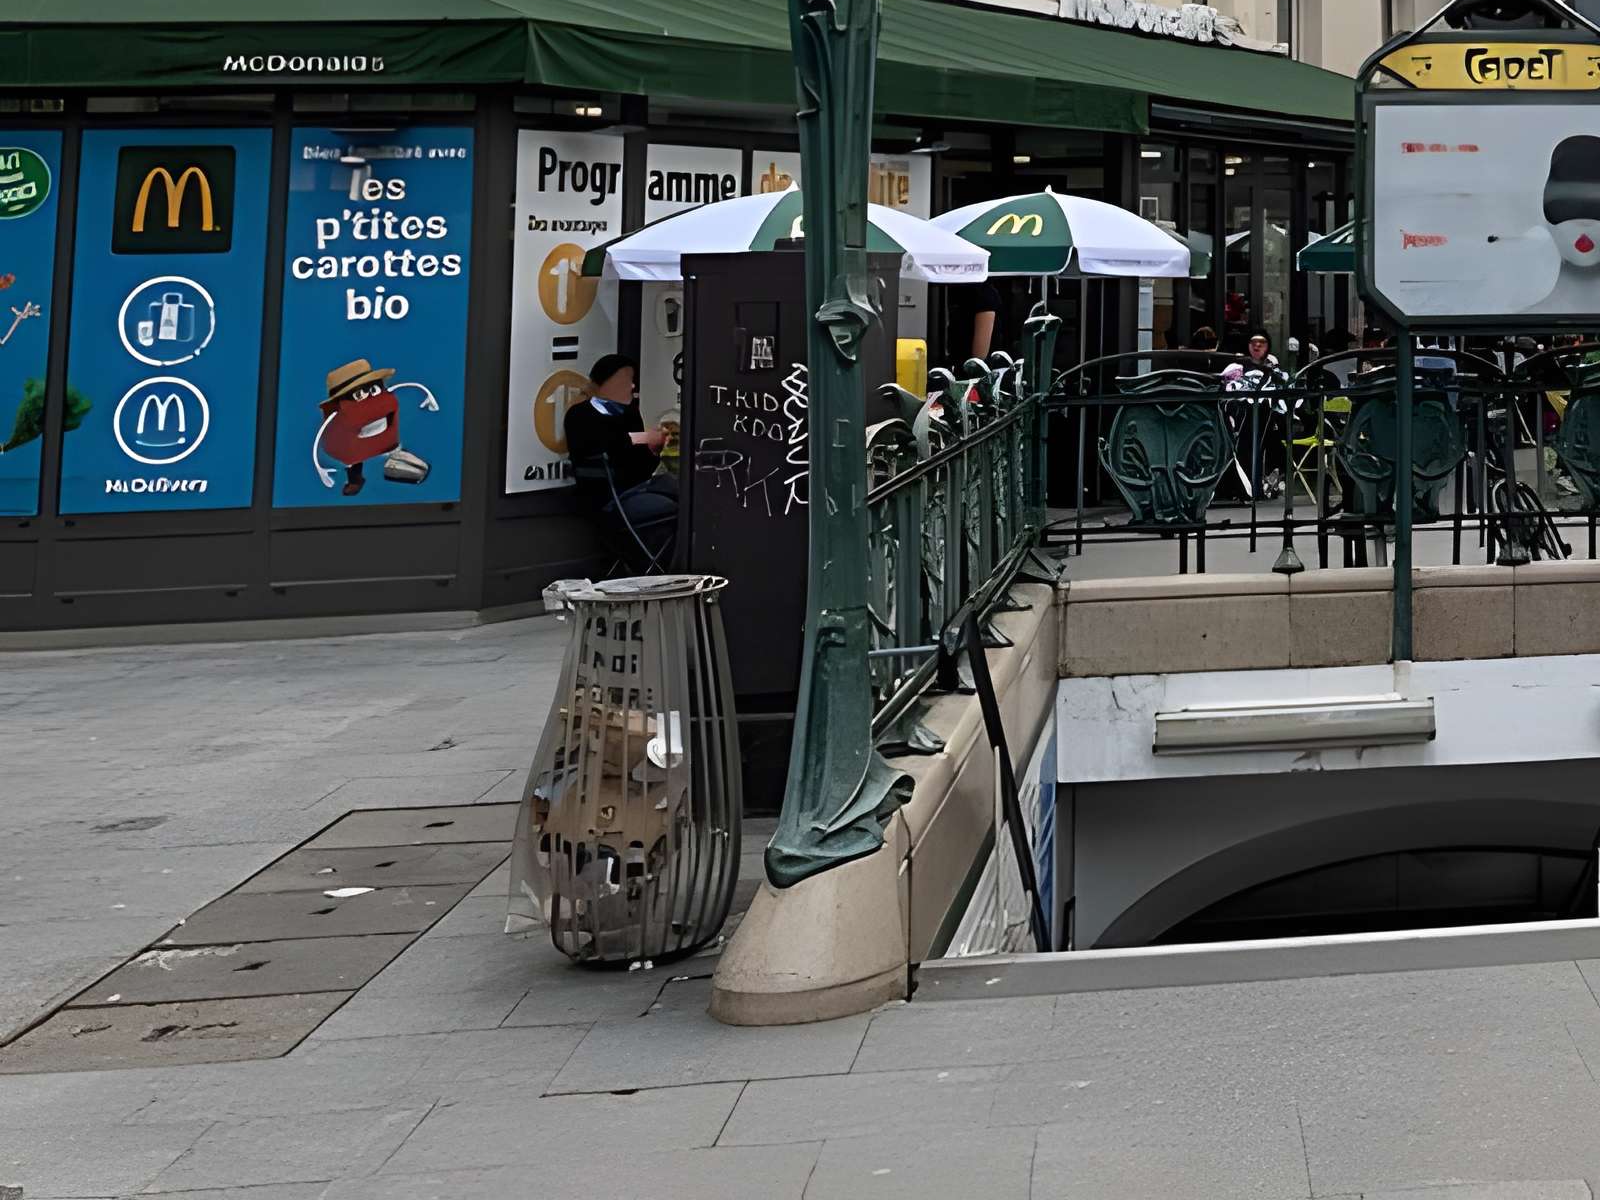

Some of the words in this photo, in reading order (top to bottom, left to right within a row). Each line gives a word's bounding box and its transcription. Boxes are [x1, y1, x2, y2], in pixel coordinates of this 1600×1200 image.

[1464, 48, 1564, 85] CADET
[316, 207, 448, 250] p'tites
[292, 249, 462, 280] carottes
[346, 285, 410, 320] bio
